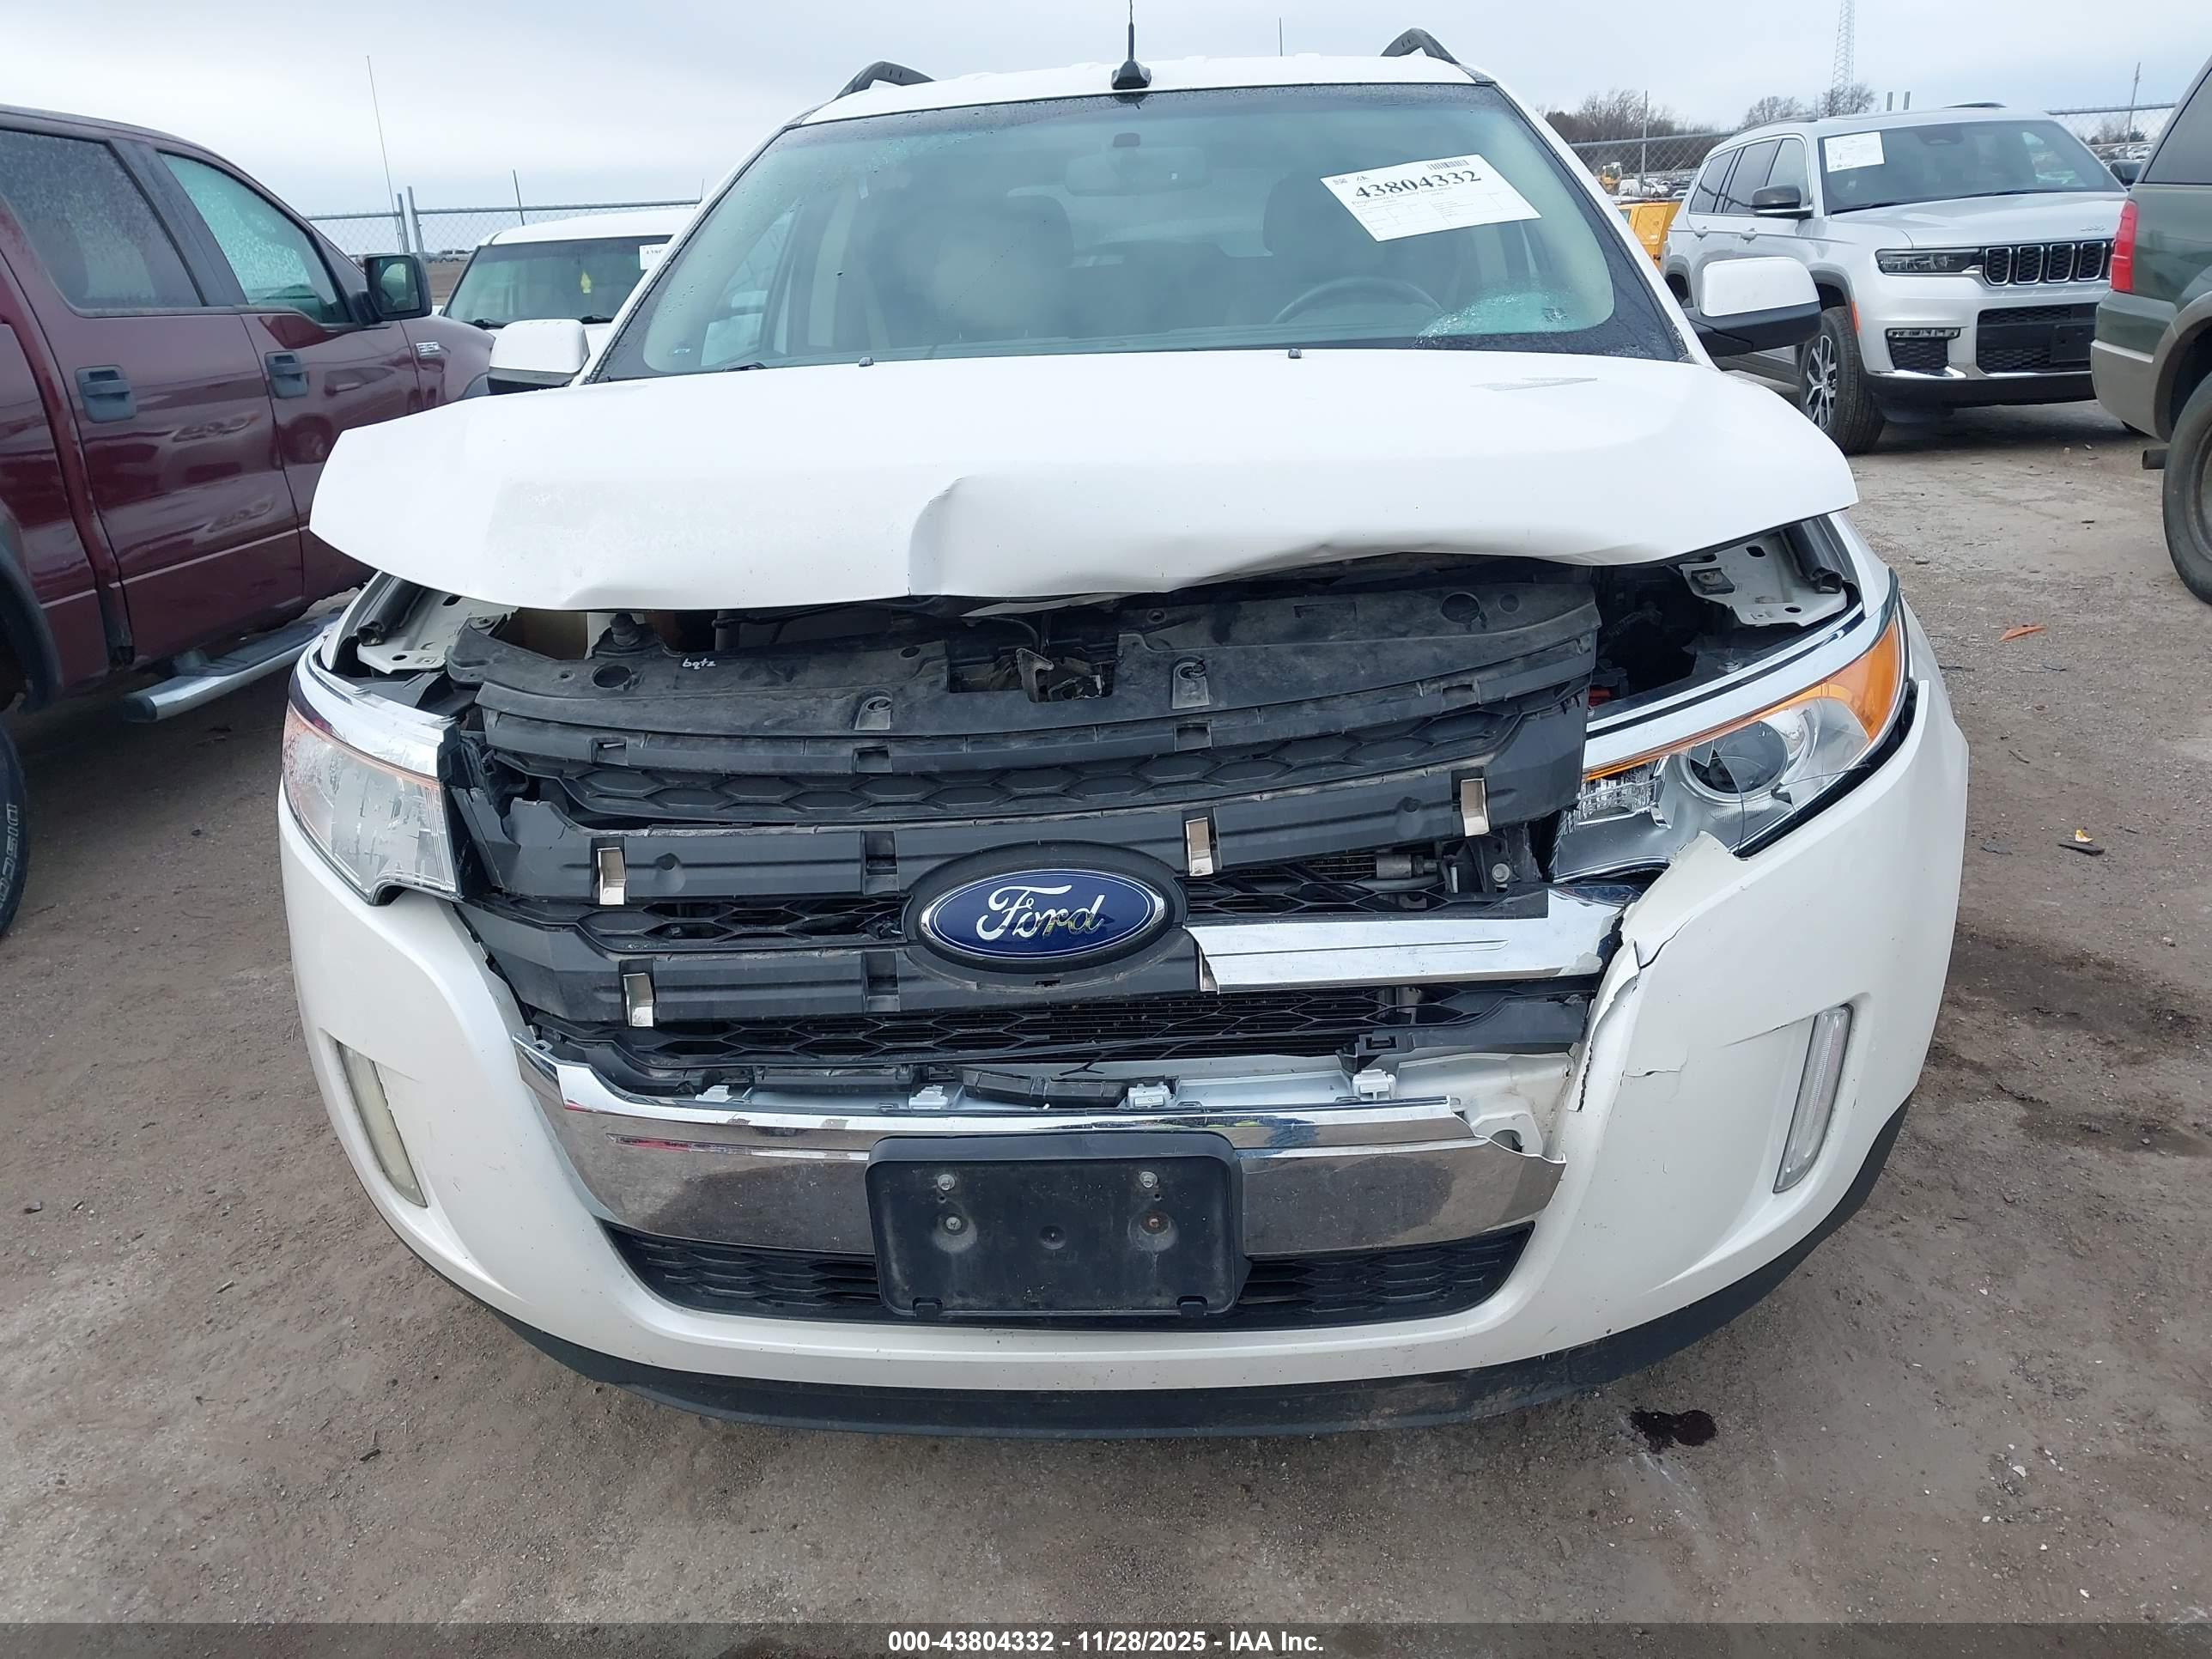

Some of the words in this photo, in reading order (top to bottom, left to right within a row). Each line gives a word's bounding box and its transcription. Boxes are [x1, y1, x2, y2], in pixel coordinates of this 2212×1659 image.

[1355, 170, 1482, 198] 43804332
[0, 803, 18, 909] DISCO
[975, 884, 1106, 942] Ford
